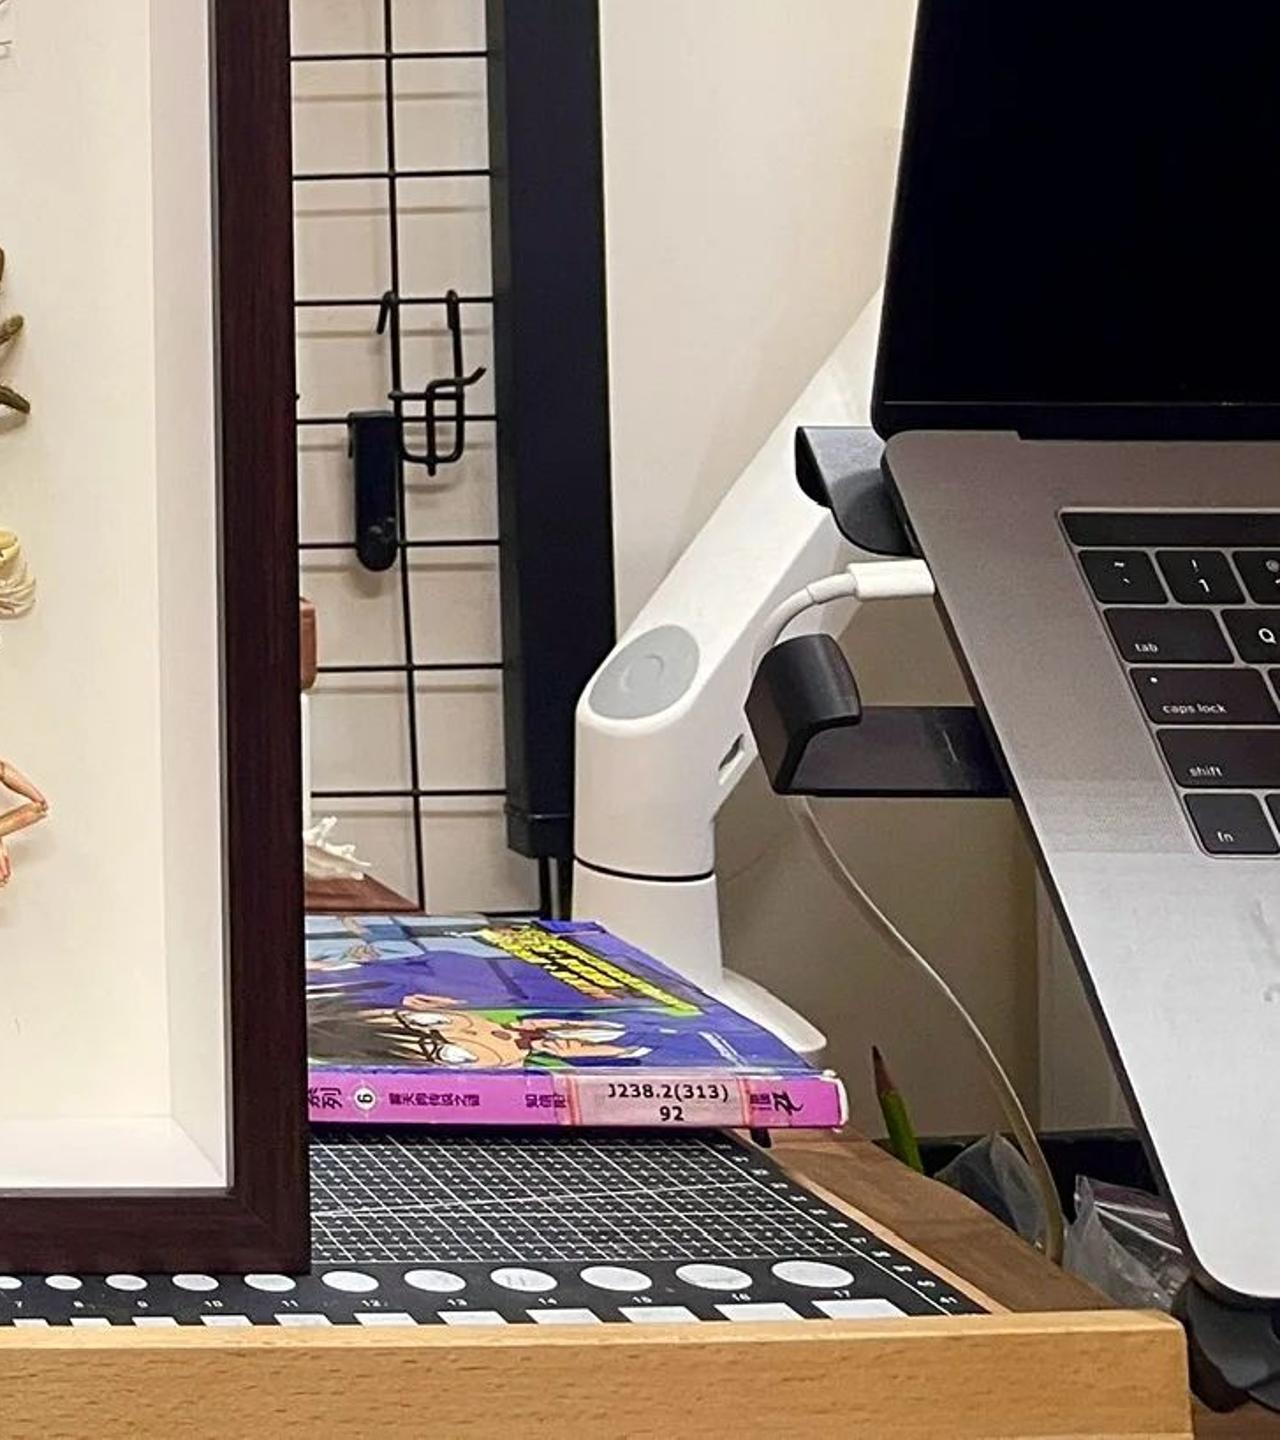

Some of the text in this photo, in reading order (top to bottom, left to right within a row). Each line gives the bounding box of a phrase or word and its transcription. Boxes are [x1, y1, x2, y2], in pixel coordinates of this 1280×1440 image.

[1258, 627, 1276, 644] Q
[1135, 642, 1159, 653] tab
[1162, 702, 1227, 714] caps lock
[1189, 765, 1223, 777] shift
[1216, 831, 1234, 843] fn
[659, 1107, 684, 1122] 92
